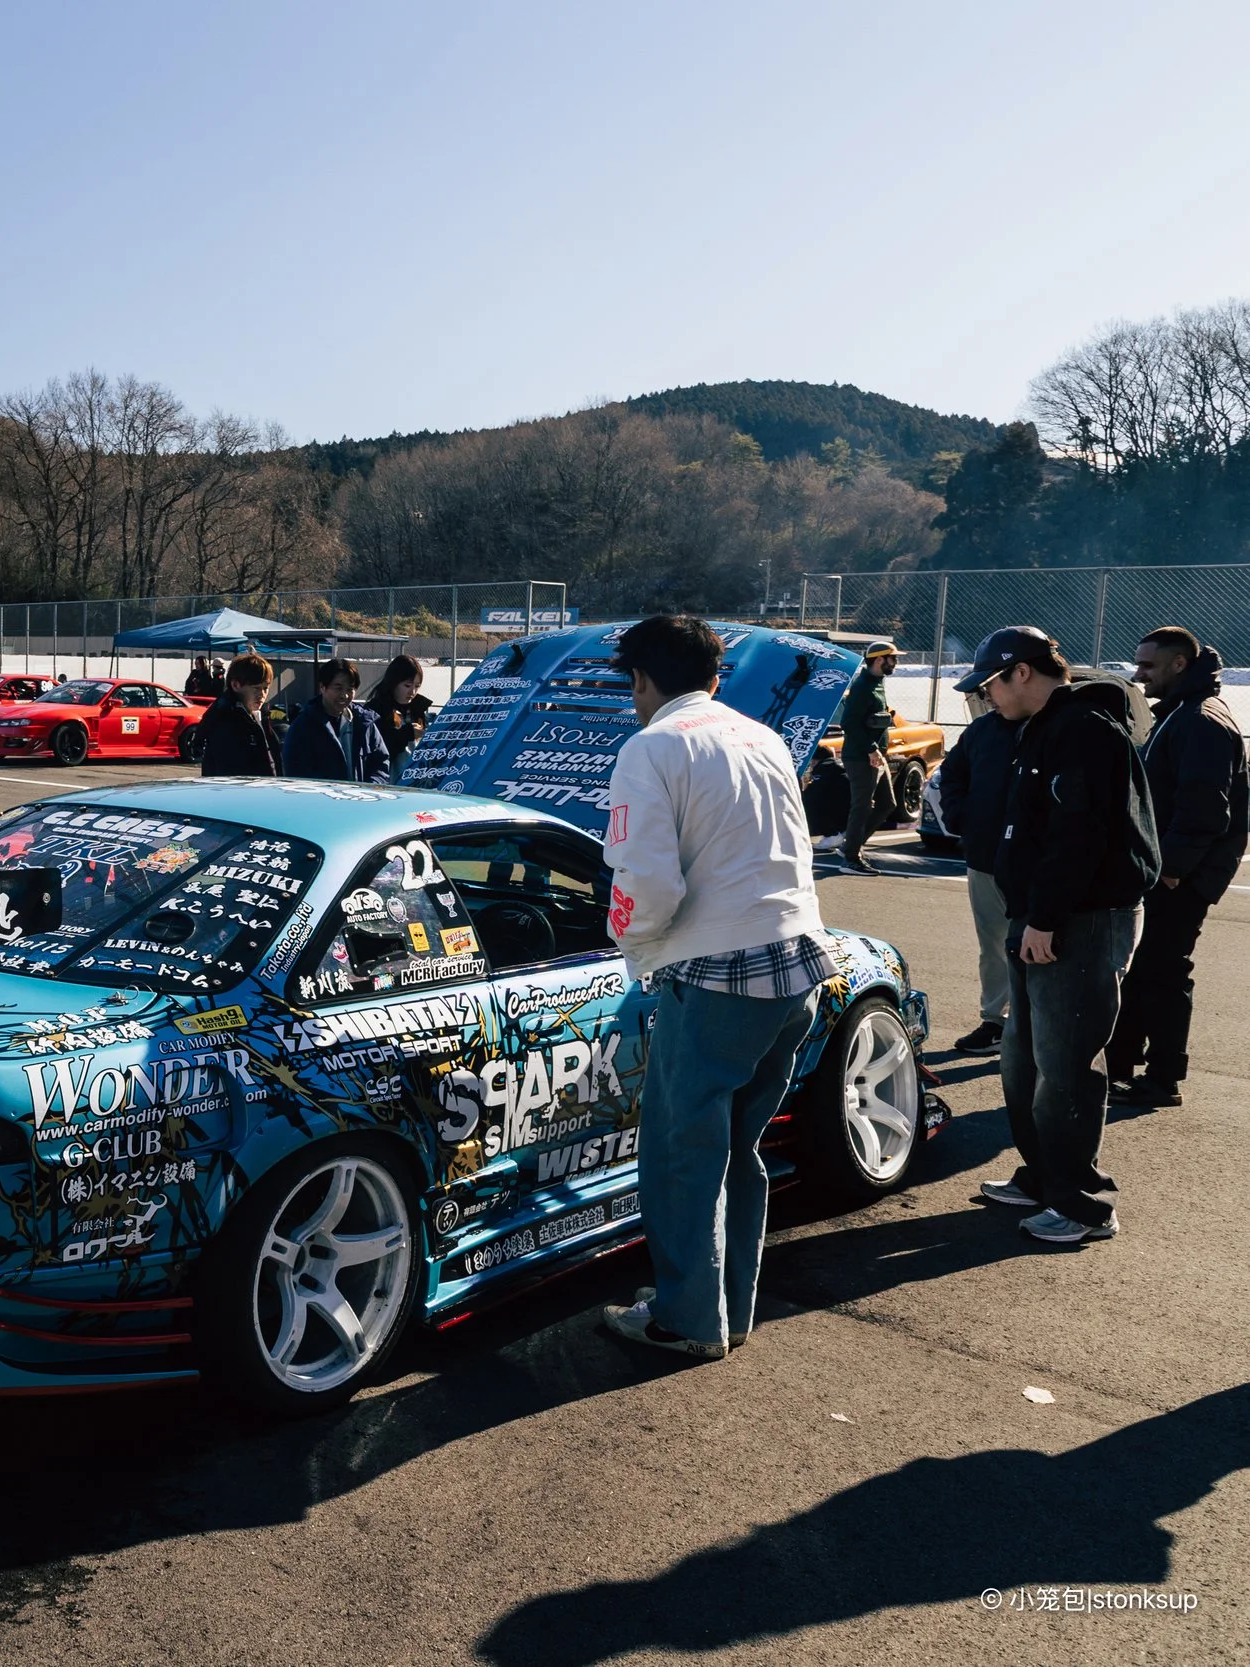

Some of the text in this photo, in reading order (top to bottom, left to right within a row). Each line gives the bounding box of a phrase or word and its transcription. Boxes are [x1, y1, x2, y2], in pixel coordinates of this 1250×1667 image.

[486, 611, 572, 622] FALKEN
[125, 722, 136, 731] 99
[523, 721, 625, 747] FROST
[512, 760, 607, 774] HANDYMAN
[515, 749, 617, 765] WORKS
[518, 773, 579, 785] SERVICE
[92, 815, 206, 842] CREST
[29, 834, 139, 866] TKL
[385, 840, 446, 891] 22
[202, 864, 303, 894] MIZUKI
[347, 911, 388, 923] AUTO FACTORY
[402, 967, 435, 984] MCR
[435, 959, 484, 979] Factory
[410, 953, 473, 969] total car service
[195, 1008, 239, 1025] Hash9
[202, 1021, 229, 1030] MOTOR
[290, 994, 465, 1050] SHIBATA
[158, 1031, 237, 1054] CAR MODIFY
[322, 1034, 462, 1072] MOTOR SPORT
[22, 1048, 256, 1130] WONDER
[437, 1032, 623, 1142] SPARK
[63, 1130, 162, 1168] G-CLUB
[538, 1126, 639, 1182] WISTE
[72, 1217, 115, 1234] 有限会社
